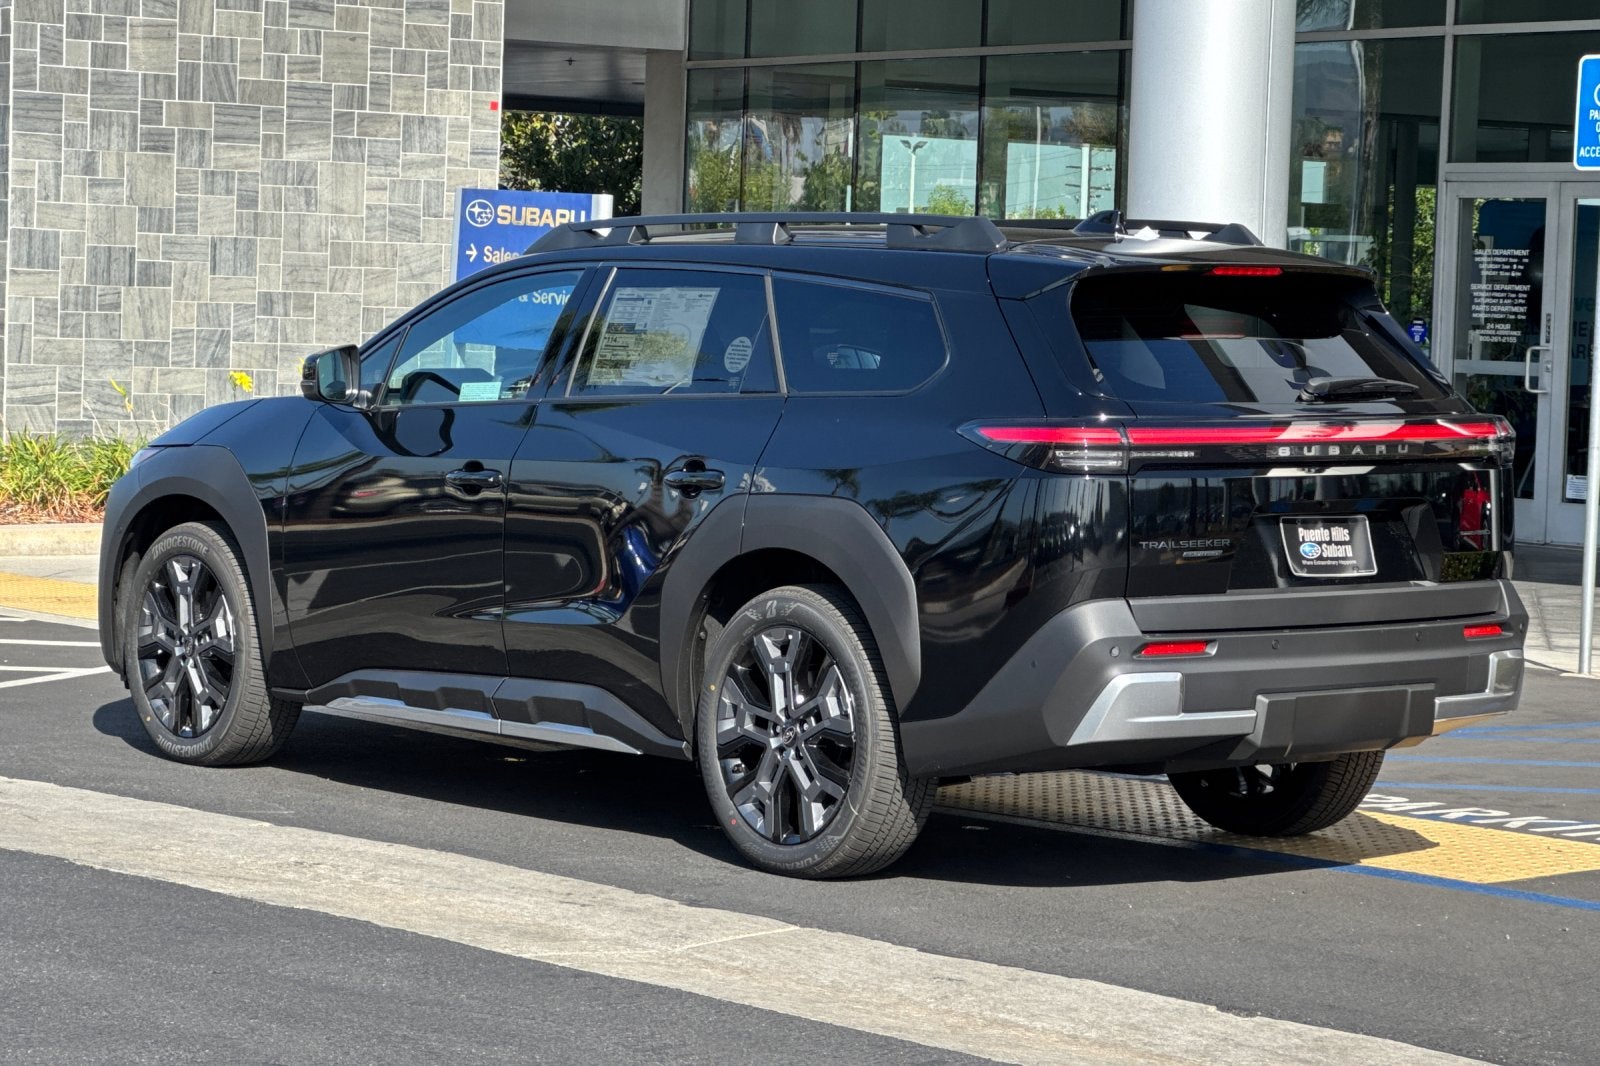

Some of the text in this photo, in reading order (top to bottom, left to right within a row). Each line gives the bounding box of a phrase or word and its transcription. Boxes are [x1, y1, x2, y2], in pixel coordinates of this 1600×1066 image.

[1278, 444, 1409, 457] SUBARU
[1297, 526, 1350, 542] Puente Hills
[1139, 538, 1231, 549] TRAILSEEKER
[1321, 543, 1353, 558] Subaru
